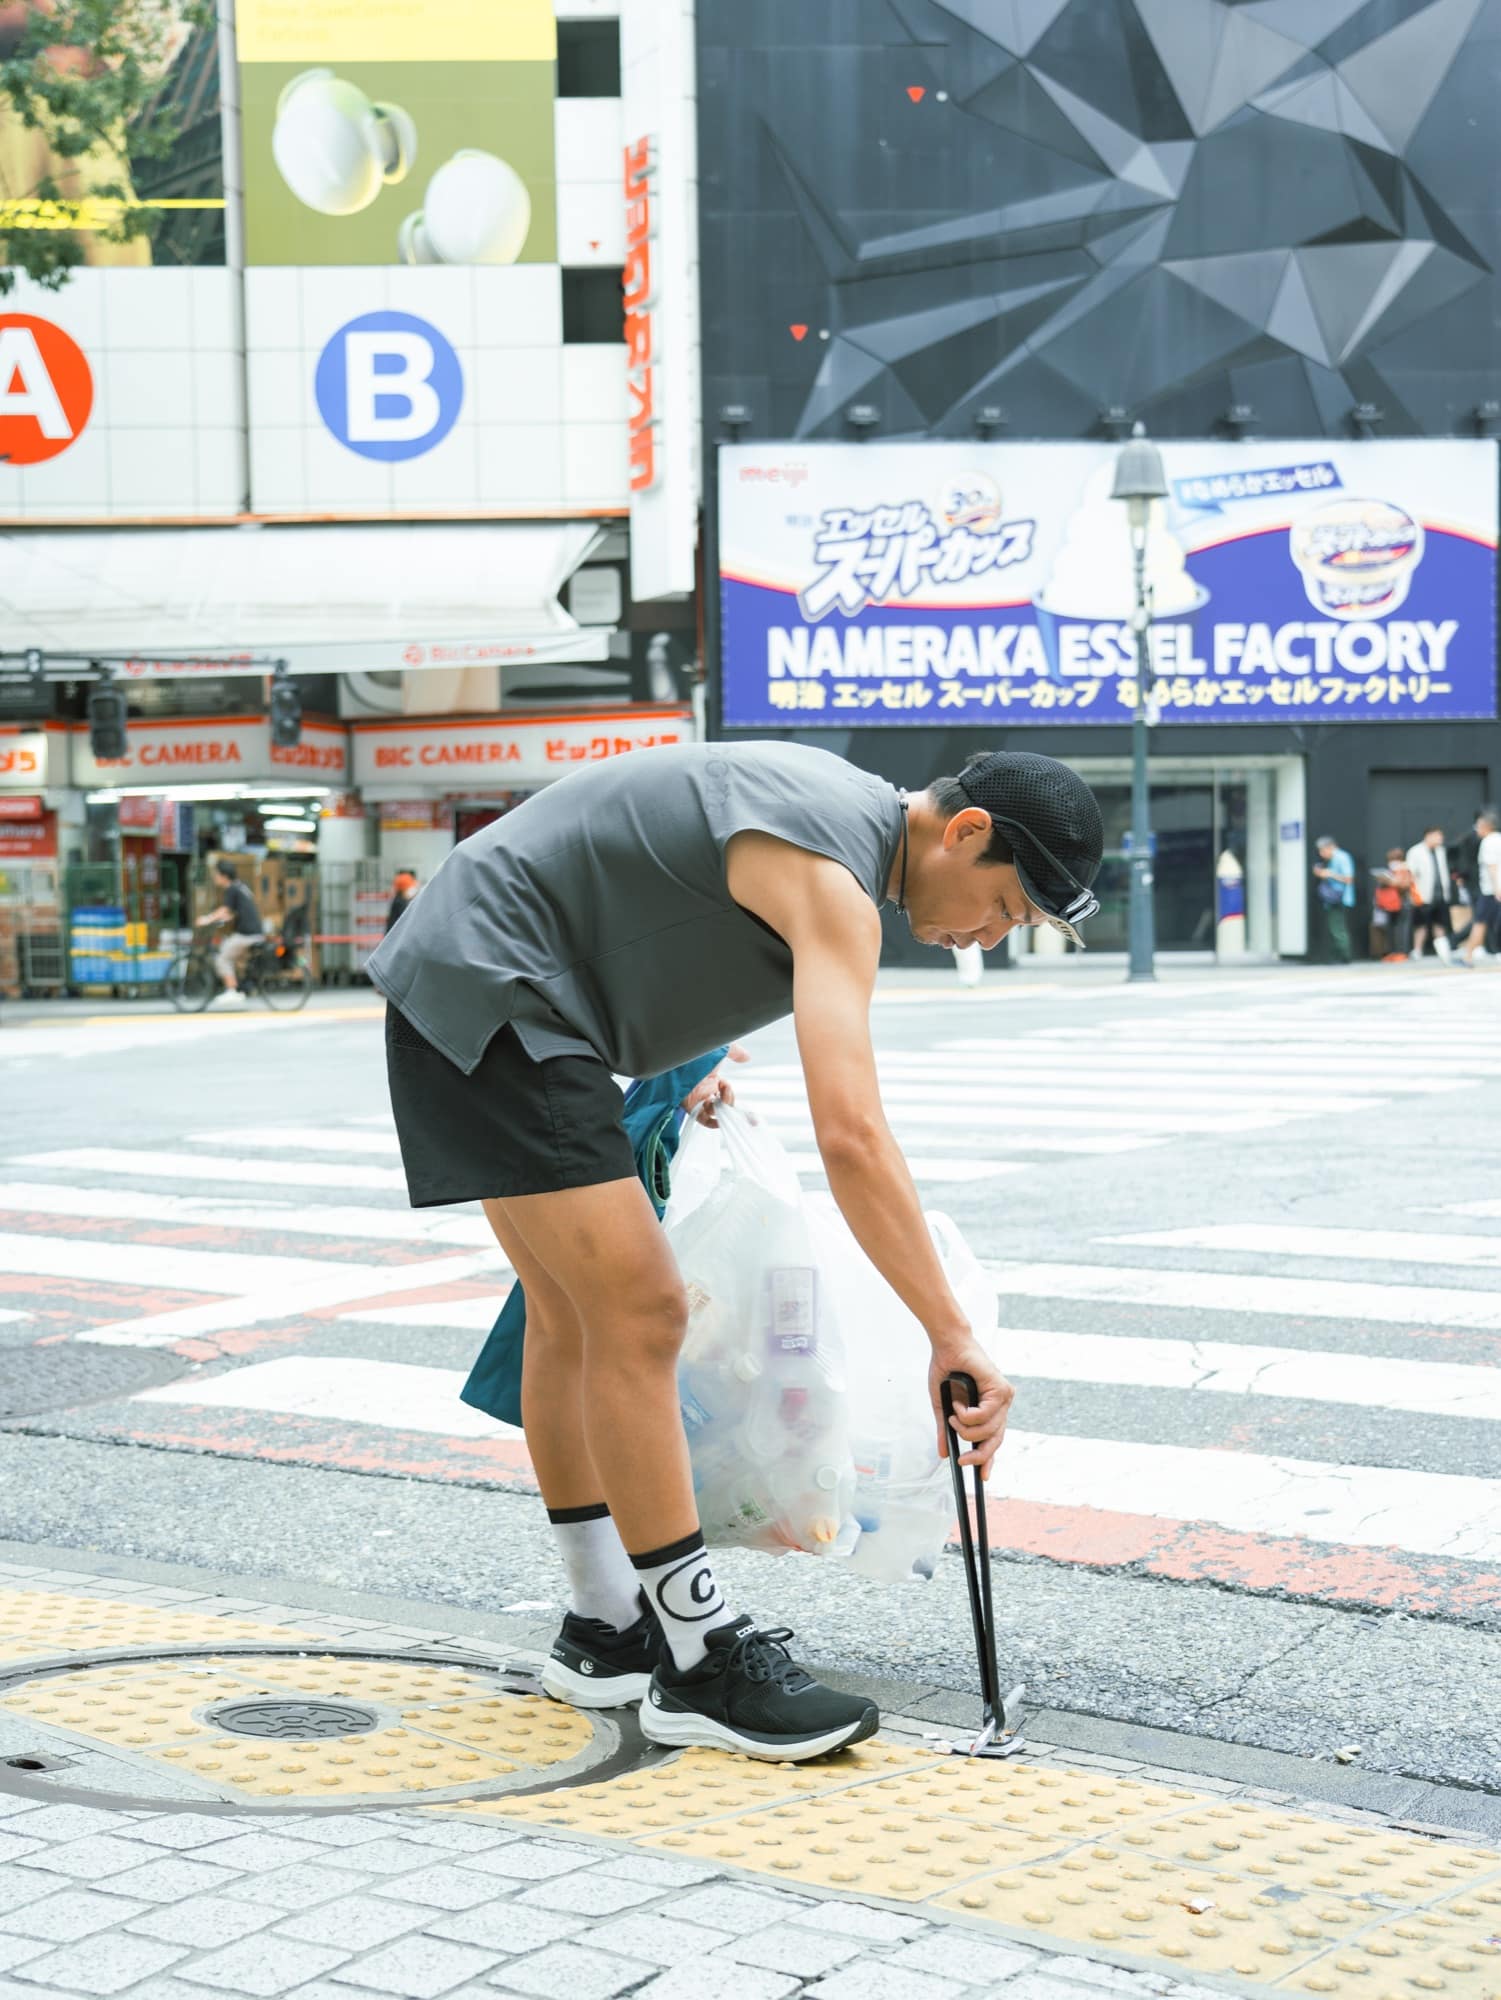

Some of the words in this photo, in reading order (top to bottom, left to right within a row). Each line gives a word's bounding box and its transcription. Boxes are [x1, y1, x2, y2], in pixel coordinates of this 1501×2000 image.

[0, 328, 73, 439] A
[345, 331, 441, 442] B
[767, 626, 1049, 678] NAMERAKA
[1059, 624, 1205, 677] ESSEL
[1213, 620, 1459, 674] FACTORY
[768, 680, 826, 709] 明治
[832, 681, 933, 708] エッセル
[938, 678, 1104, 708] スーパーカップ
[138, 741, 242, 766] CAMERA
[375, 745, 414, 768] BIC
[420, 742, 521, 766] CAMERA
